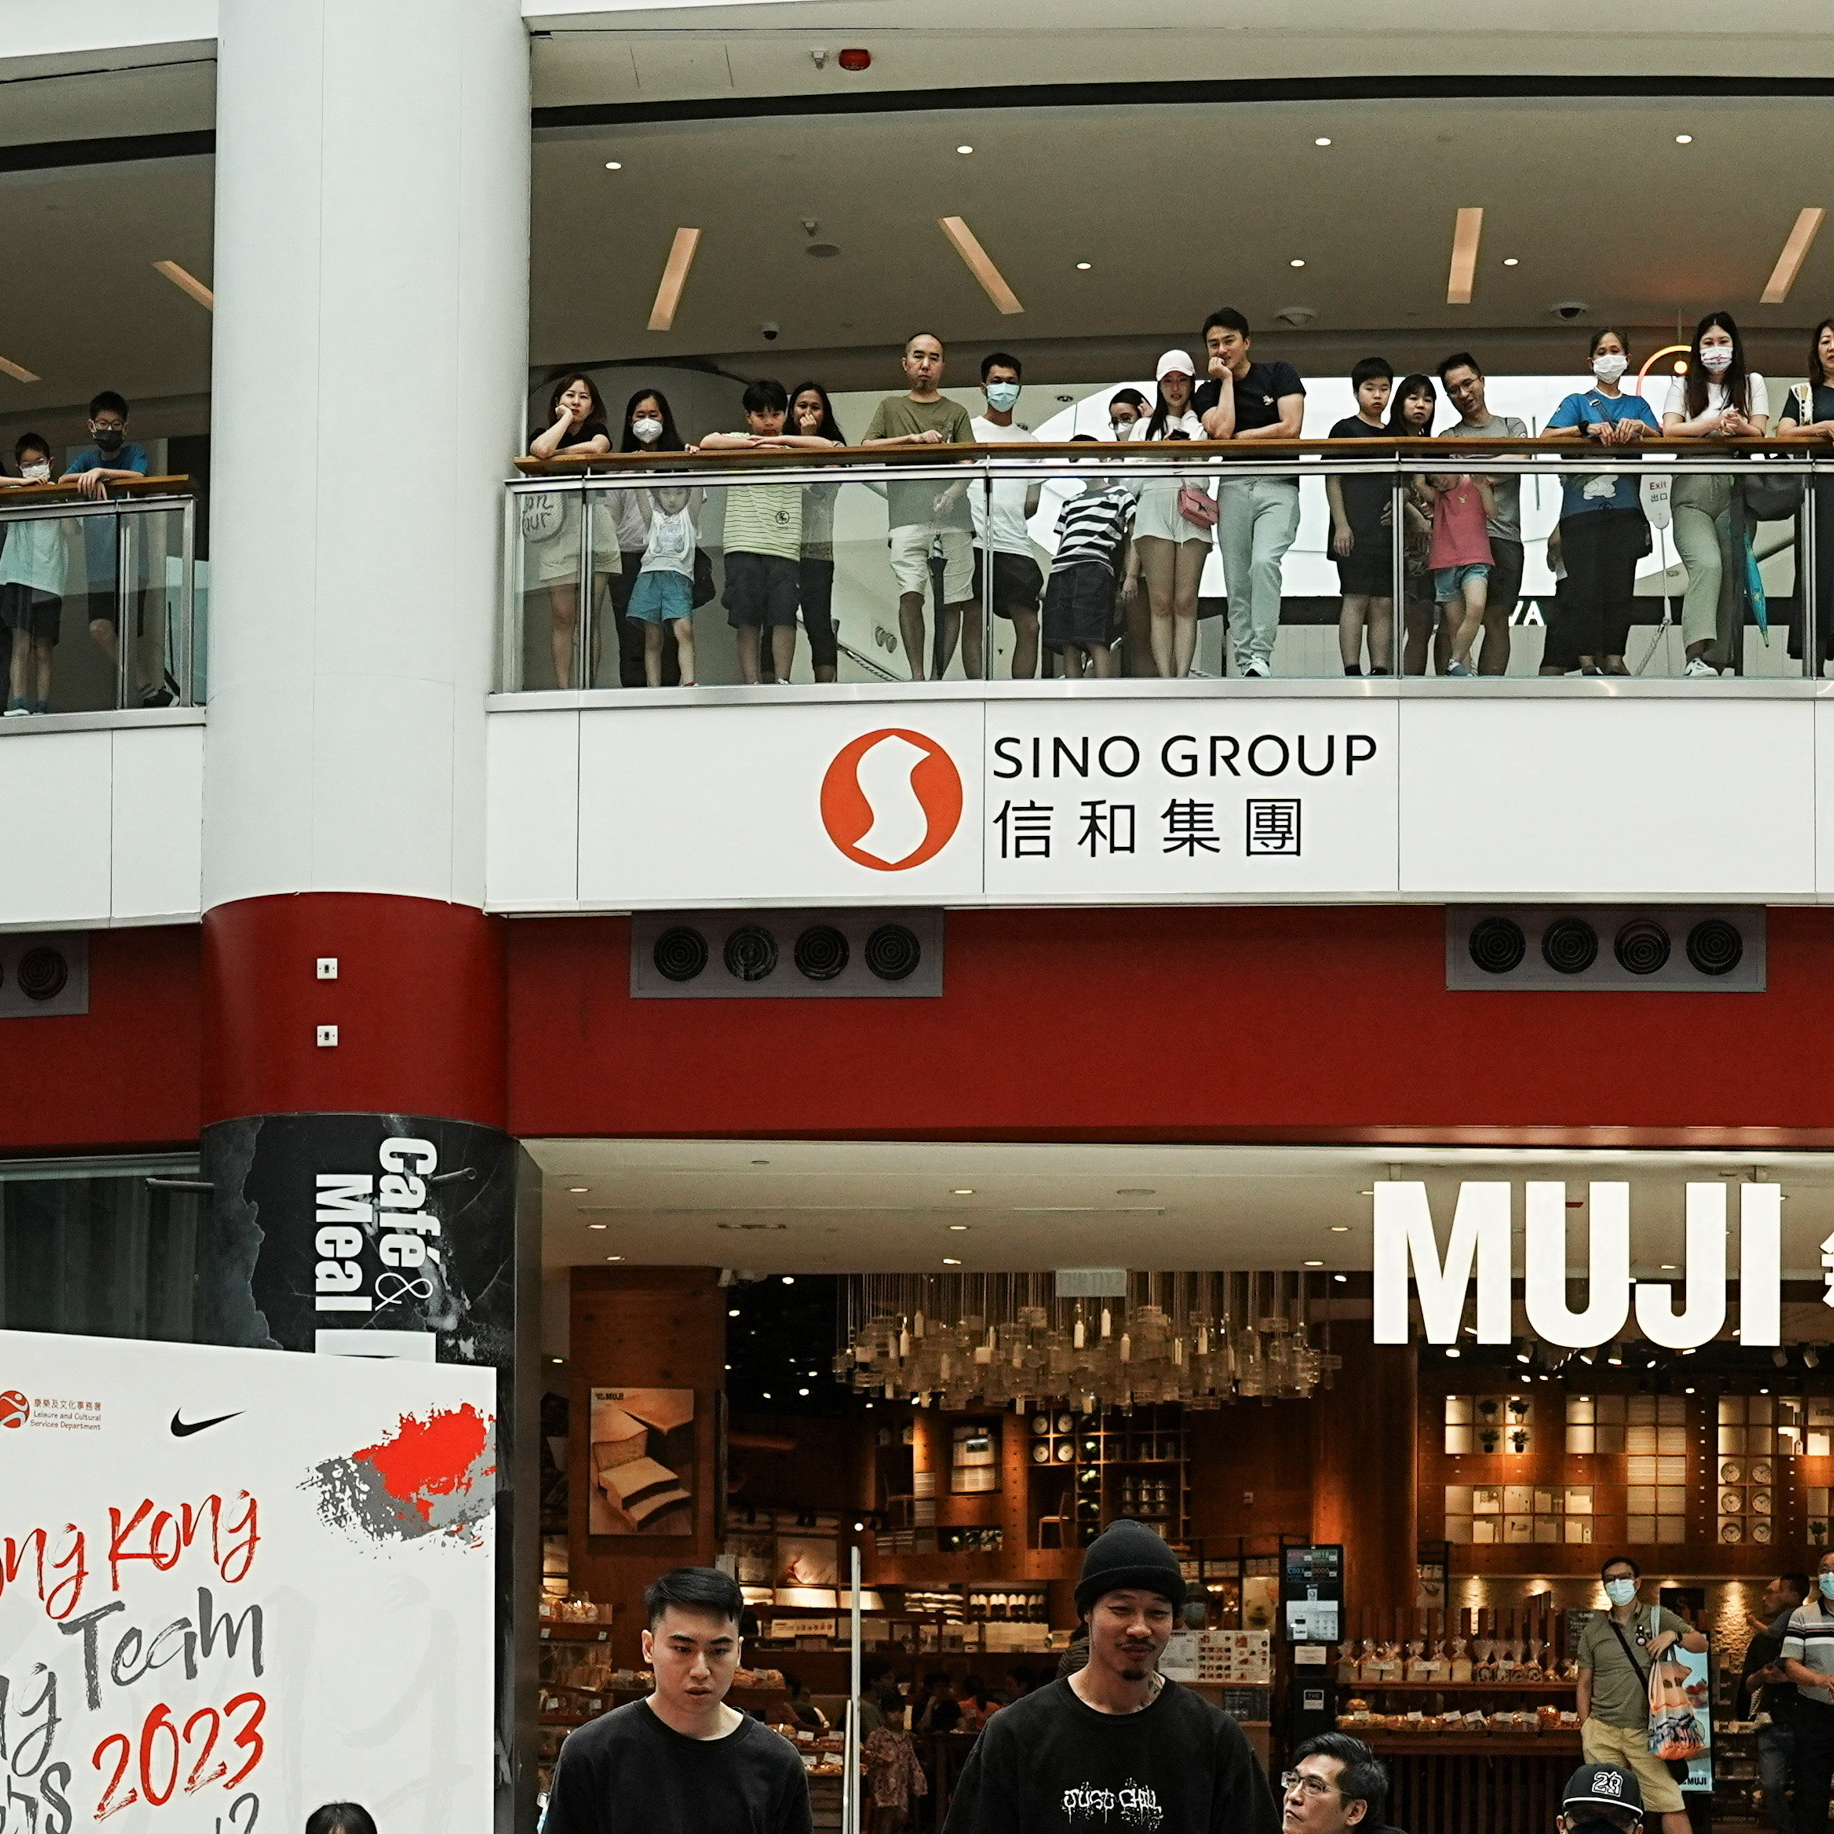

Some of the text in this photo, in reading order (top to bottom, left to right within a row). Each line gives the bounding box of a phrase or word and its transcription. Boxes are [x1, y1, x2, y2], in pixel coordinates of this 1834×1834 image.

[1649, 481, 1667, 490] Exit
[1650, 493, 1668, 502] 出口
[992, 733, 1377, 779] SINO GROUP
[992, 798, 1302, 858] 信和集團
[379, 1136, 442, 1268] Café
[315, 1174, 374, 1312] Meal
[1373, 1181, 1782, 1349] MUJI
[374, 1272, 434, 1311] &
[30, 1420, 101, 1431] Services Department
[33, 1410, 101, 1421] Leisure and Cultural
[108, 1489, 262, 1592] Kong
[57, 1586, 265, 1711] Team
[92, 1691, 267, 1823] 2023
[1063, 1785, 1115, 1812] JUST
